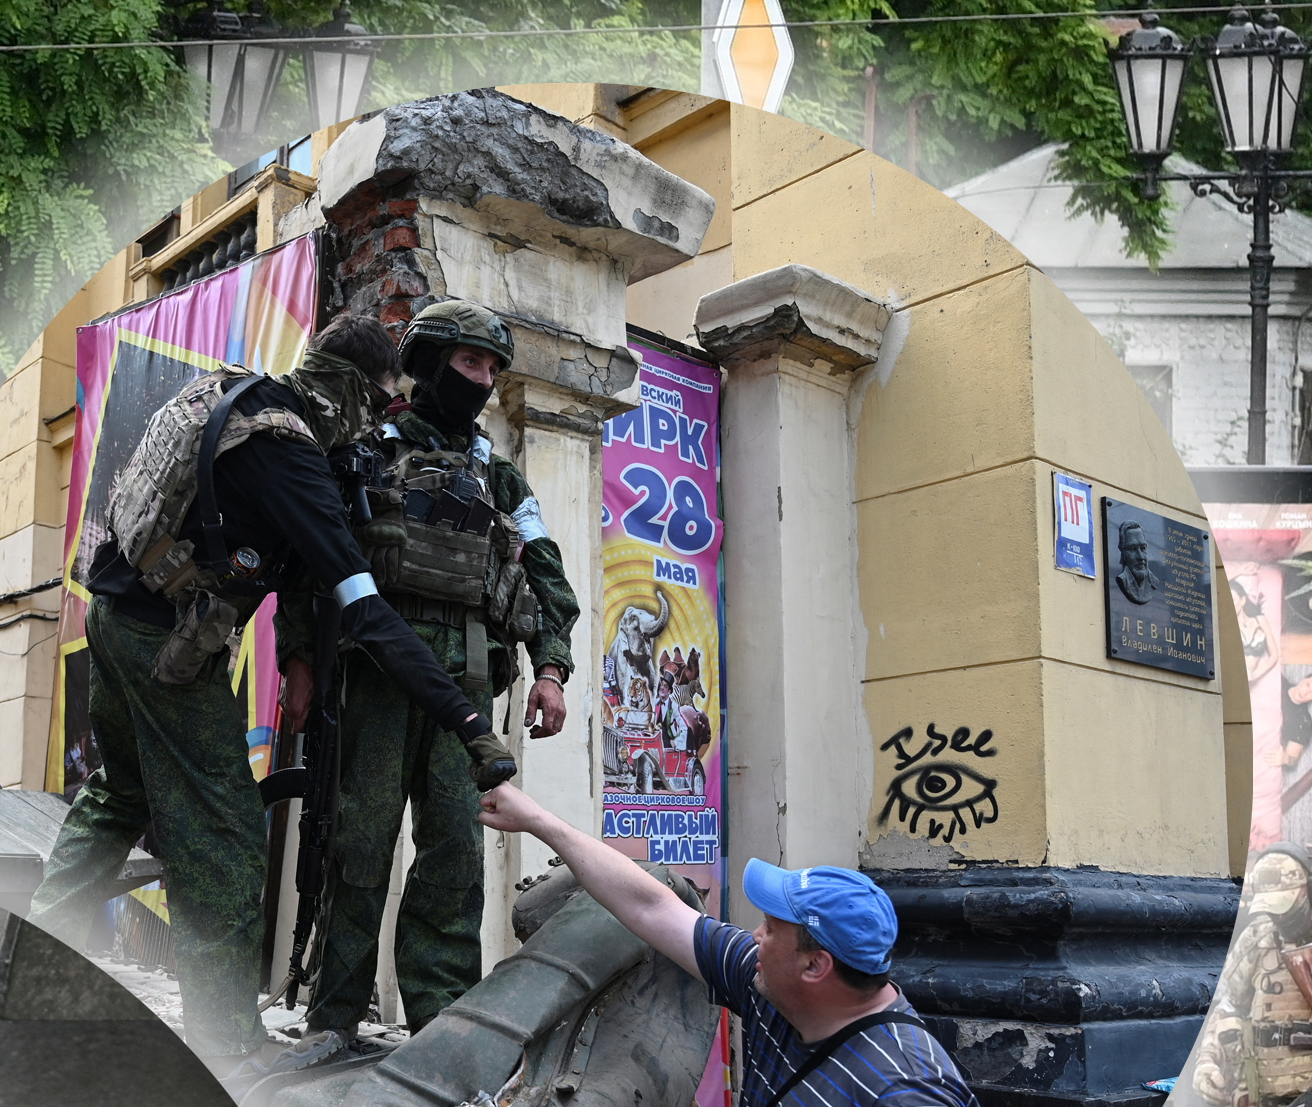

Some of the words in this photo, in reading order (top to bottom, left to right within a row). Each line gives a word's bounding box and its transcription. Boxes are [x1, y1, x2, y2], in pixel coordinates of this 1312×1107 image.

[654, 367, 681, 383] ЦИРКОВАЯ
[681, 378, 713, 392] КОМПАНИЯ
[640, 383, 682, 410] ВСКИЙ
[620, 463, 715, 555] 28
[1062, 490, 1084, 526] ПГ
[655, 557, 698, 587] мая
[1122, 616, 1206, 651] ЛЕВШИН
[1122, 635, 1163, 654] Владилен
[1167, 646, 1206, 665] Иванович
[880, 726, 933, 770] I
[926, 722, 997, 758] see
[603, 794, 643, 804] АЗОЧНОЕ
[643, 795, 687, 806] ЦИРКОВОЕ
[687, 795, 707, 806] ШОУ
[604, 809, 717, 837] АСТЛИВЫЙ
[649, 838, 718, 864] БИЛЕТ
